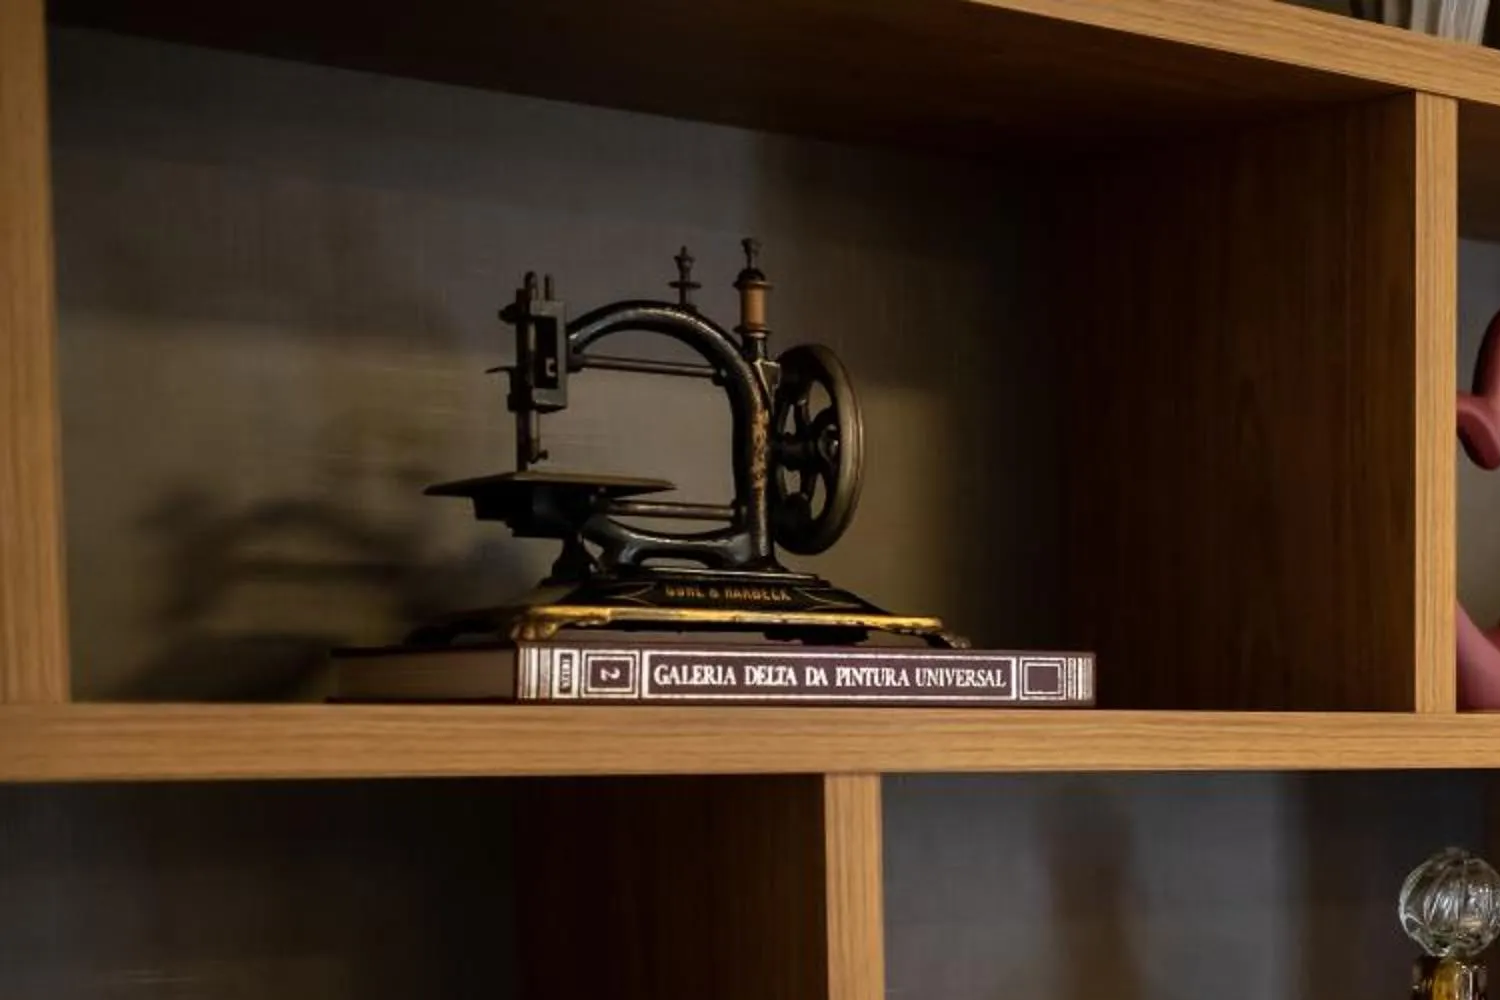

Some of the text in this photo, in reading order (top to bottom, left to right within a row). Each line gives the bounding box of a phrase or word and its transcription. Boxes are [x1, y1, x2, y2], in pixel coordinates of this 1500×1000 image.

[600, 667, 621, 682] 2
[653, 664, 1008, 689] GALERIA DELTA DA PINTURA UNIVERSAL
